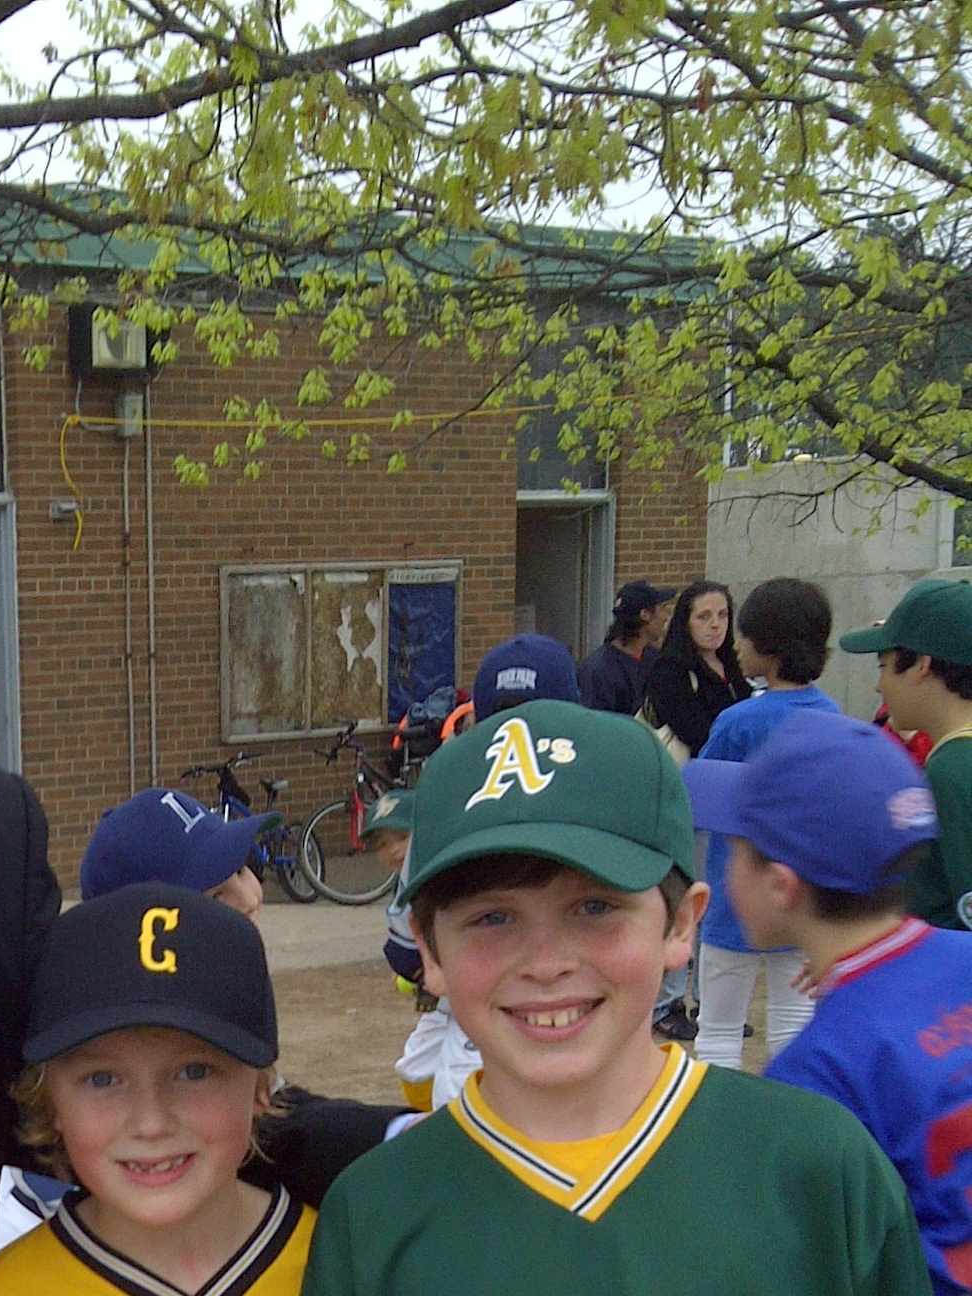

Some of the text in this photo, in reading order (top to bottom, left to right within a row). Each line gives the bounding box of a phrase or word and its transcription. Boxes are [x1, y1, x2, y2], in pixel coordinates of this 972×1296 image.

[465, 717, 576, 812] A's
[161, 791, 206, 833] L
[138, 906, 180, 974] C
